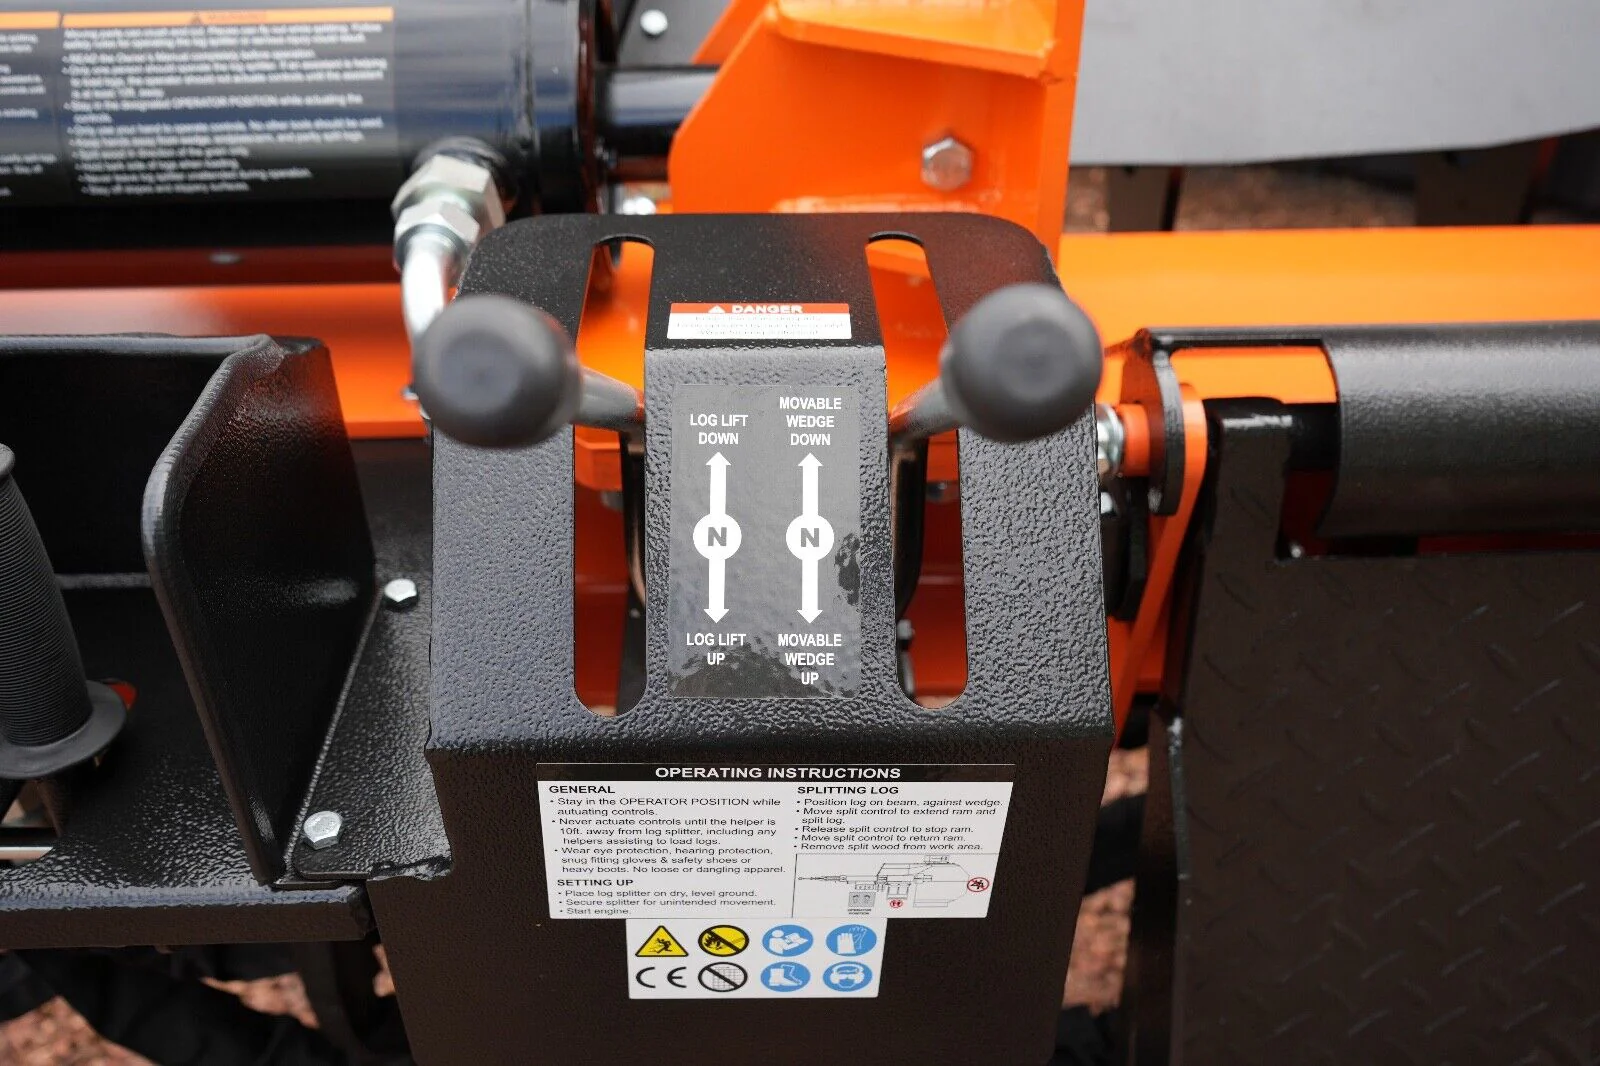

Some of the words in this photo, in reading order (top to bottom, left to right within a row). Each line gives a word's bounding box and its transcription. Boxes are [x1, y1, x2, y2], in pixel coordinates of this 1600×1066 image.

[732, 304, 804, 314] DANGER
[780, 397, 842, 410] MOVABLE
[690, 414, 718, 426] LOG
[722, 414, 748, 426] LIFT
[786, 415, 834, 428] WEDGE
[698, 432, 738, 444] DOWN
[790, 434, 831, 446] DOWN
[708, 526, 728, 546] N
[800, 528, 820, 547] N
[686, 633, 714, 646] LOG
[718, 633, 746, 646] LIFT
[778, 634, 842, 646] MOVABLE
[707, 653, 726, 666] UP
[785, 653, 834, 666] WEDGE
[801, 672, 820, 684] UP
[655, 767, 762, 778] OPERATING
[768, 767, 901, 779] INSTRUCTIONS
[548, 785, 616, 794] GENERAL
[797, 786, 867, 795] SPLITTING
[870, 786, 899, 795] LOG
[557, 797, 583, 807] Stay
[598, 798, 616, 806] the
[619, 797, 688, 806] OPERATOR
[691, 798, 750, 806] POSITION
[850, 798, 867, 808] log
[886, 798, 920, 806] beam,
[923, 798, 962, 808] against
[965, 798, 1002, 808] wedge.
[836, 807, 858, 816] split
[730, 818, 764, 827] helper
[802, 816, 823, 825] split
[826, 816, 845, 826] log.
[645, 828, 662, 837] log
[665, 828, 703, 837] splitter,
[706, 828, 754, 837] including
[849, 825, 871, 834] split
[926, 826, 948, 834] stop
[563, 837, 603, 846] helpers
[606, 837, 653, 847] assisting
[696, 838, 721, 847] logs.
[834, 834, 856, 843] split
[616, 847, 672, 856] protection,
[675, 847, 715, 856] hearing
[718, 847, 773, 856] protection,
[847, 843, 869, 852] split
[590, 856, 620, 865] fitting
[622, 856, 657, 865] gloves
[671, 856, 703, 865] safety
[562, 866, 594, 874] heavy
[696, 866, 741, 875] dangling
[743, 866, 786, 874] apparel.
[557, 879, 612, 887] SETTING
[597, 890, 613, 898] log
[616, 890, 651, 898] splitter
[669, 890, 688, 898] dry,
[718, 890, 757, 898] ground.
[606, 898, 640, 907] splitter
[594, 908, 632, 916] engine.
